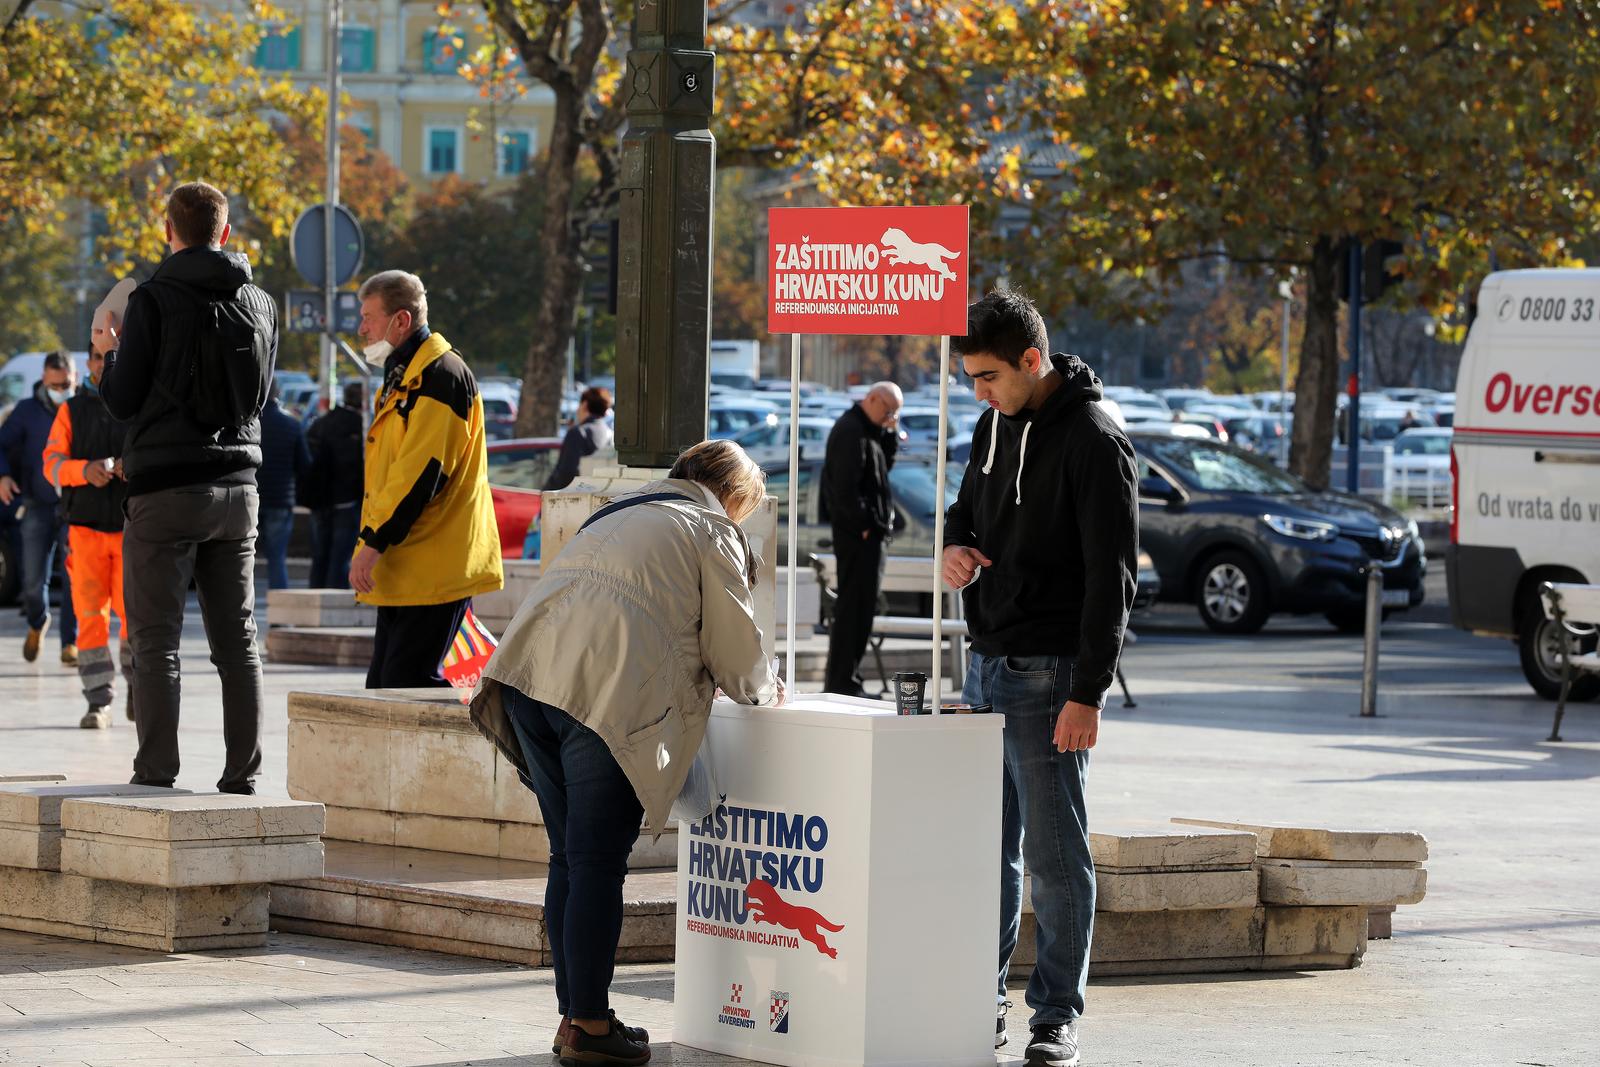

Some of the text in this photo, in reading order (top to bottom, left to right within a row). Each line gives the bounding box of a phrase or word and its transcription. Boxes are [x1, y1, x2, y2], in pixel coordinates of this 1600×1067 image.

[775, 235, 879, 270] ZAŠTITIMO
[775, 274, 945, 301] HRVATSKU KUNU
[775, 303, 899, 315] REFERENDUMSKA INICIJATIVA
[1519, 297, 1594, 321] 0800 33
[1478, 492, 1600, 522] Od vrata do v
[689, 840, 824, 893] HRVATSKU
[687, 880, 749, 925] KUNU
[687, 919, 800, 949] REFERENDUMSKA INICIJATIVA
[718, 1014, 756, 1029] SUVERENISTI
[722, 1005, 751, 1018] HRVATSKI
